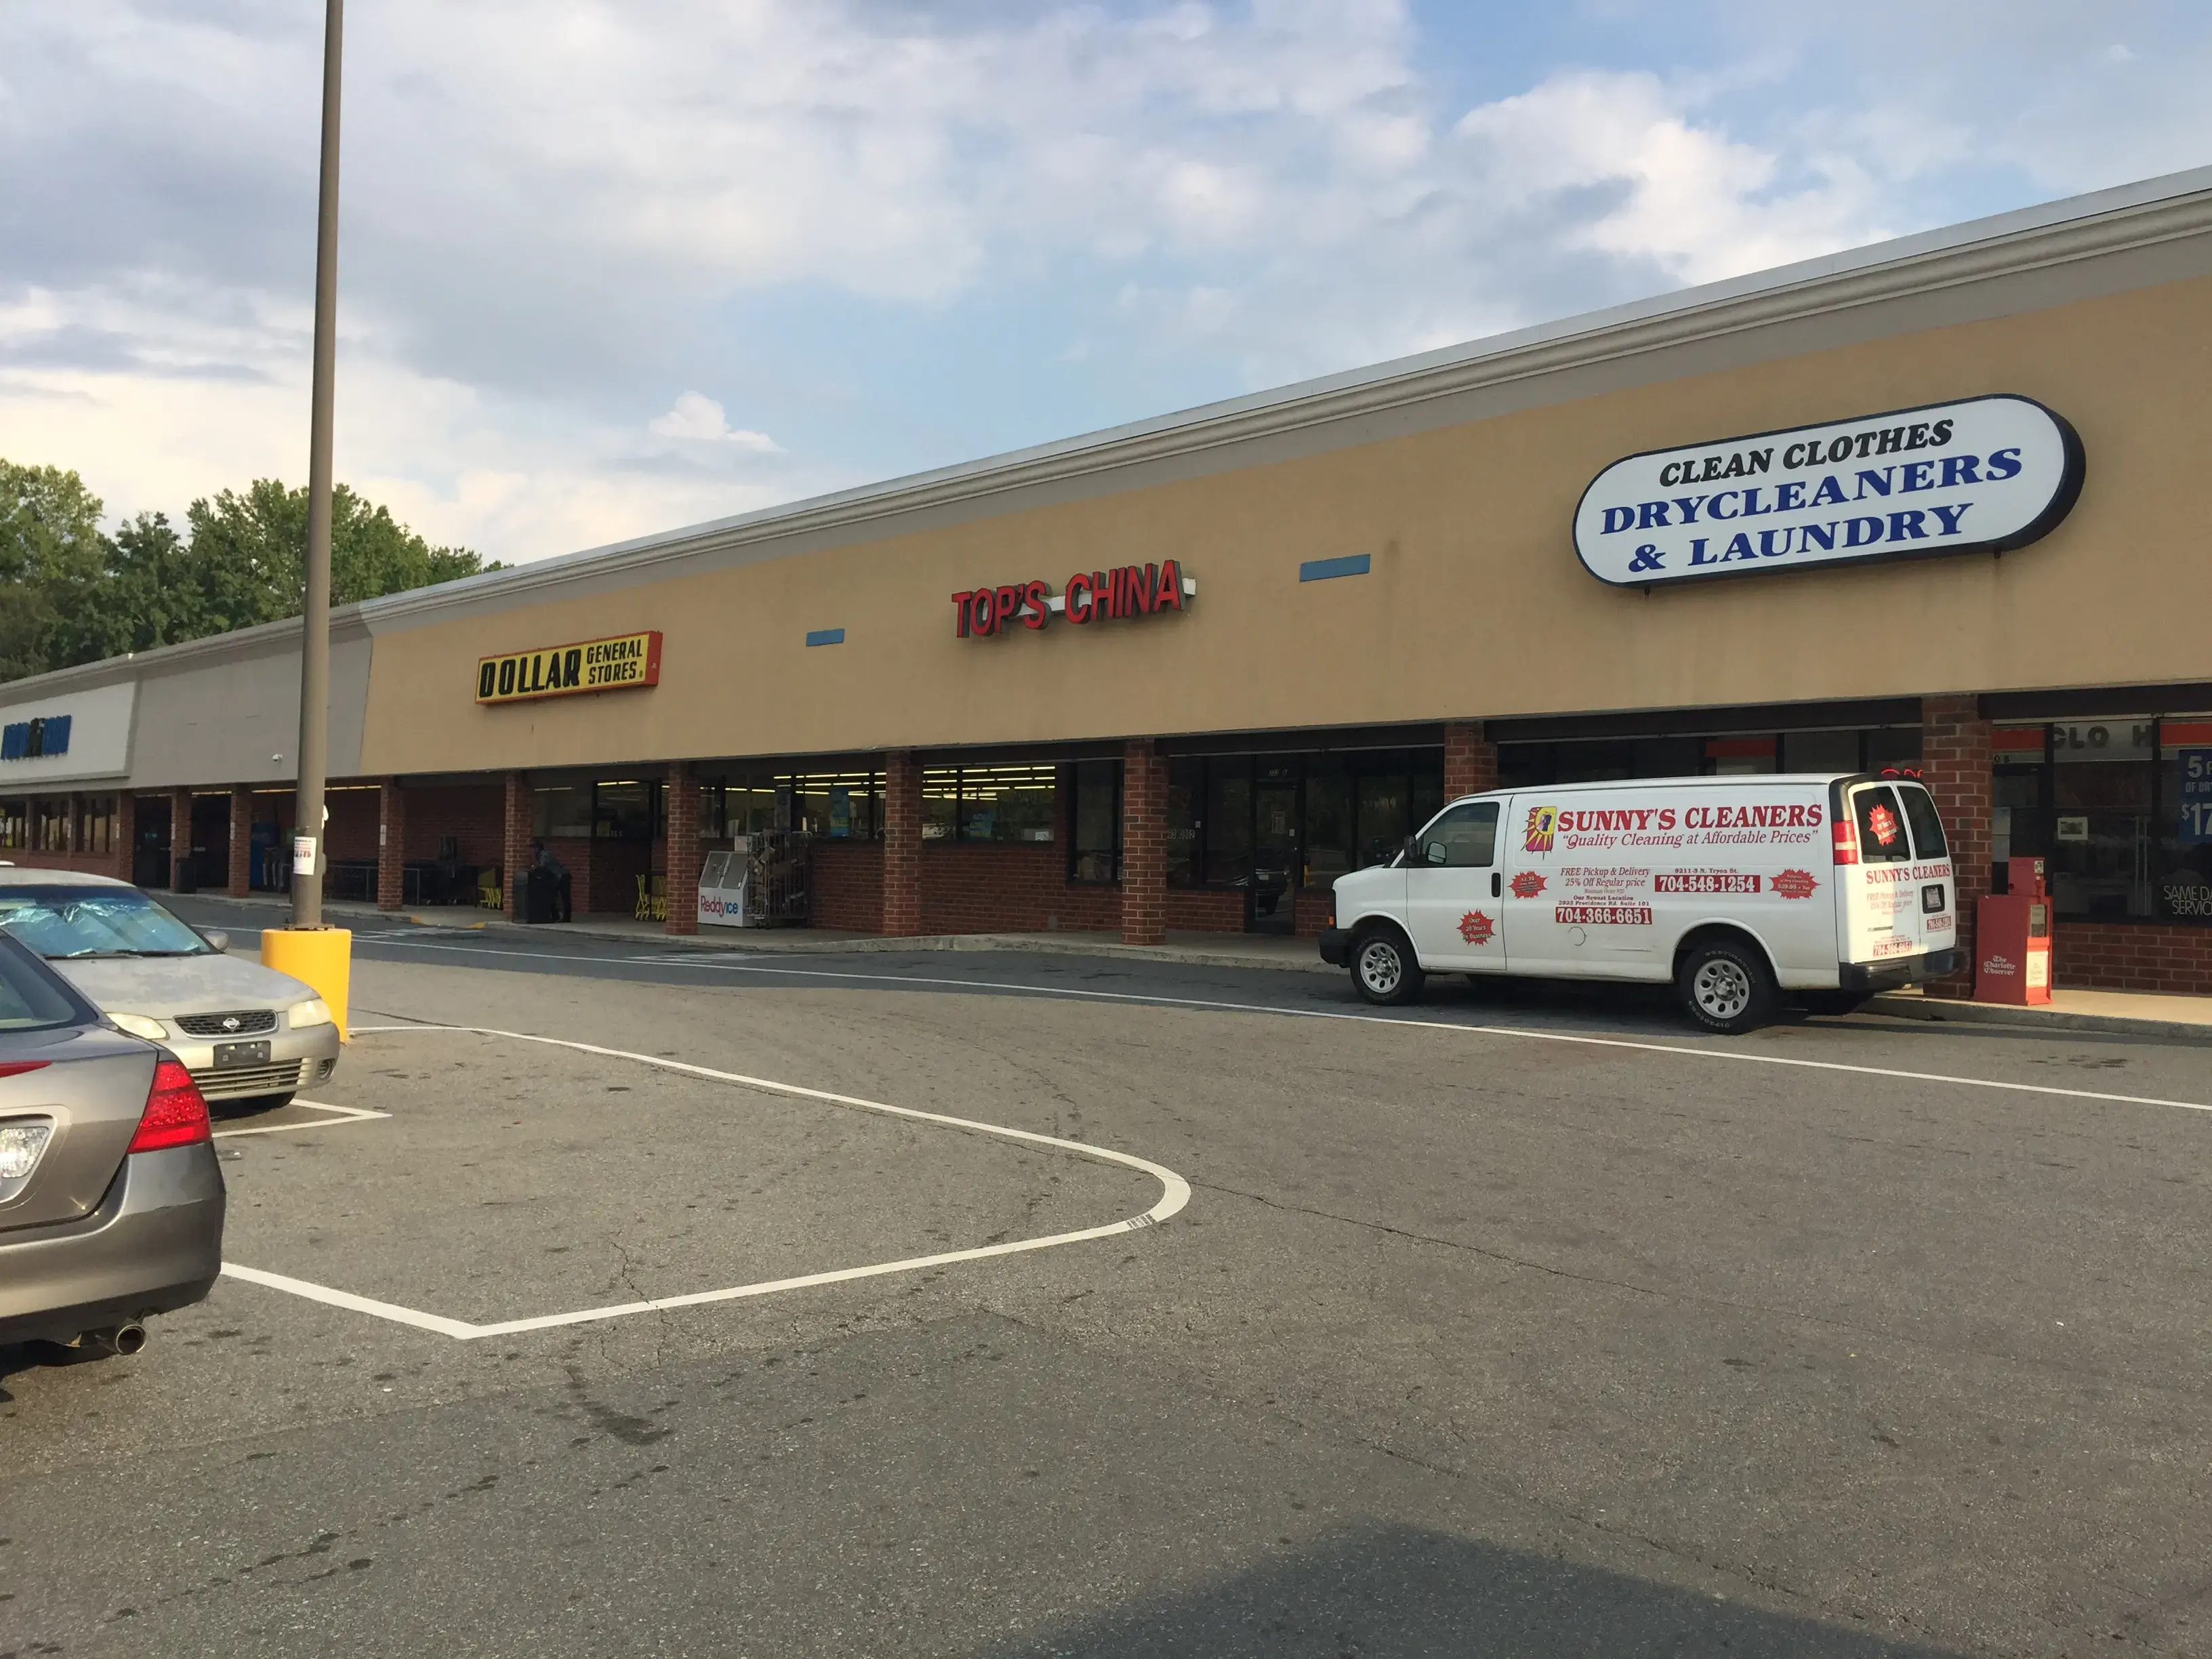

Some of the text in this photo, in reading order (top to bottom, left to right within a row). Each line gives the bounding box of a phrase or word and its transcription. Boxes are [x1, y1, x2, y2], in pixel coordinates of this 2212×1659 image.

[1660, 418, 1954, 487] CLEAN CLOTHES
[1599, 447, 2022, 535] DRYCLEANERS
[1628, 502, 1973, 573] & LAUNDRY
[951, 559, 1183, 638] TOP'S CHINA
[478, 638, 643, 698] DOLLAR GENERAL
[2188, 755, 2203, 778] 5
[2185, 781, 2212, 794] OF DR
[1557, 803, 1823, 833] SUNNY'S CLEANERS
[1621, 832, 1685, 848] Cleaning
[1686, 834, 1699, 844] at
[1701, 830, 1767, 845] Affordable
[1560, 866, 1651, 878] FREE Pickup & Delivery
[1912, 863, 1950, 880] CLEANERS
[1565, 877, 1645, 888] 25% Off Regular price
[1659, 875, 1755, 893] 704-548-1254
[2163, 884, 2212, 901] SAME D
[1557, 907, 1651, 924] 704-366-6651
